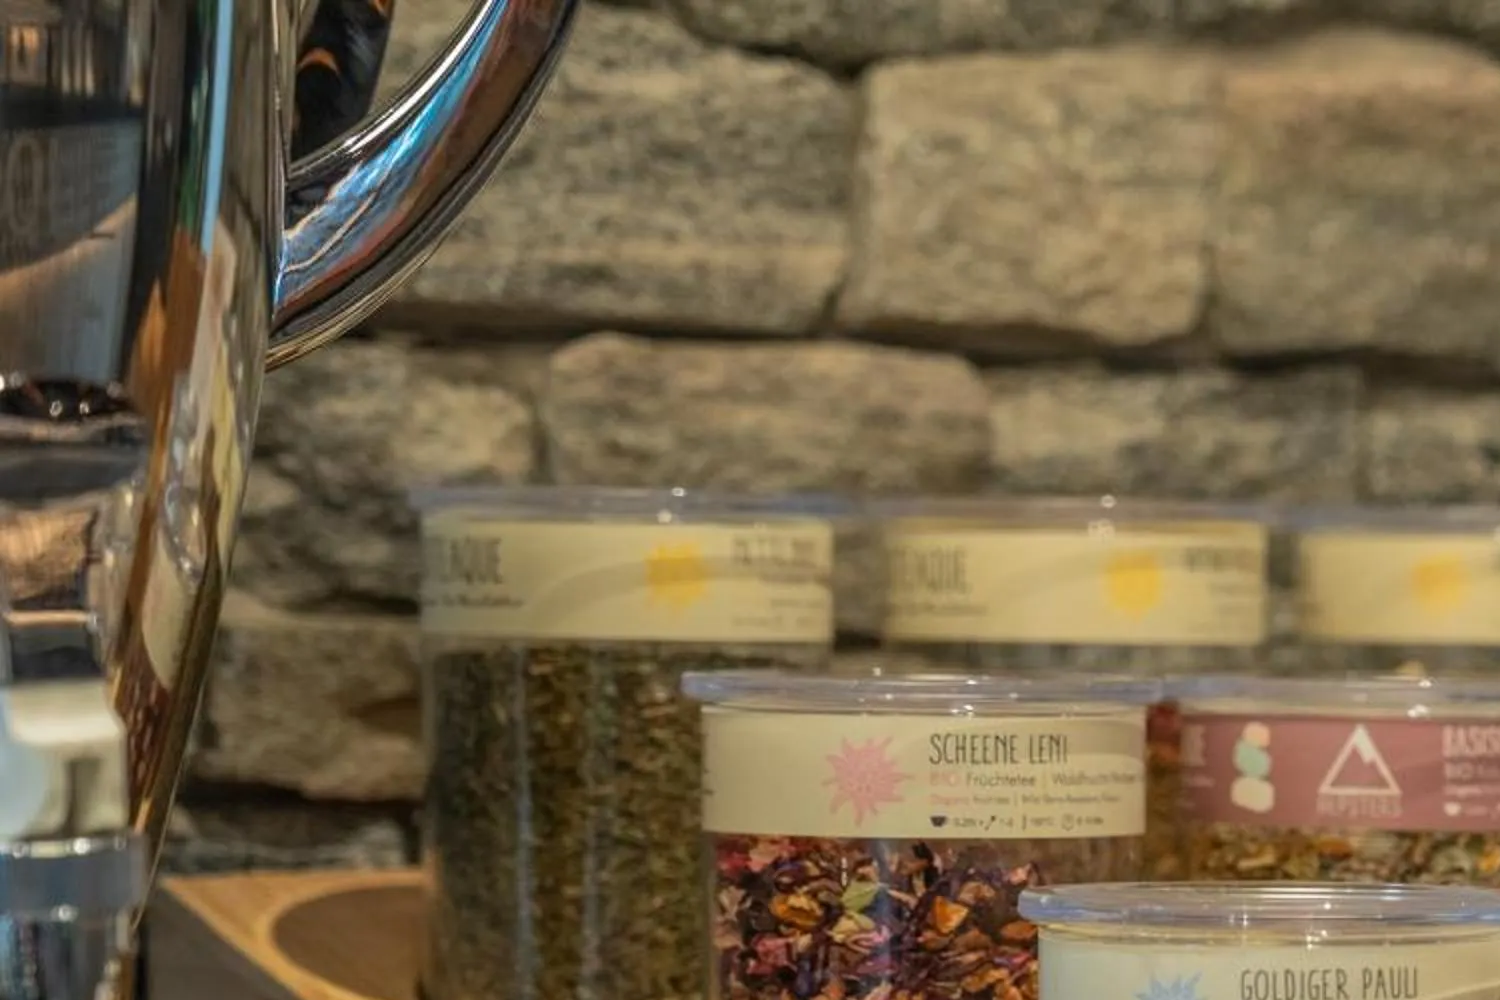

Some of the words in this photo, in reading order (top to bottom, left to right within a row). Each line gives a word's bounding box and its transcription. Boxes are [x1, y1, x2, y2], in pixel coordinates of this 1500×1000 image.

[929, 733, 1020, 766] SCHEENE
[1029, 733, 1068, 765] LENI
[1361, 965, 1418, 1000] PAULI
